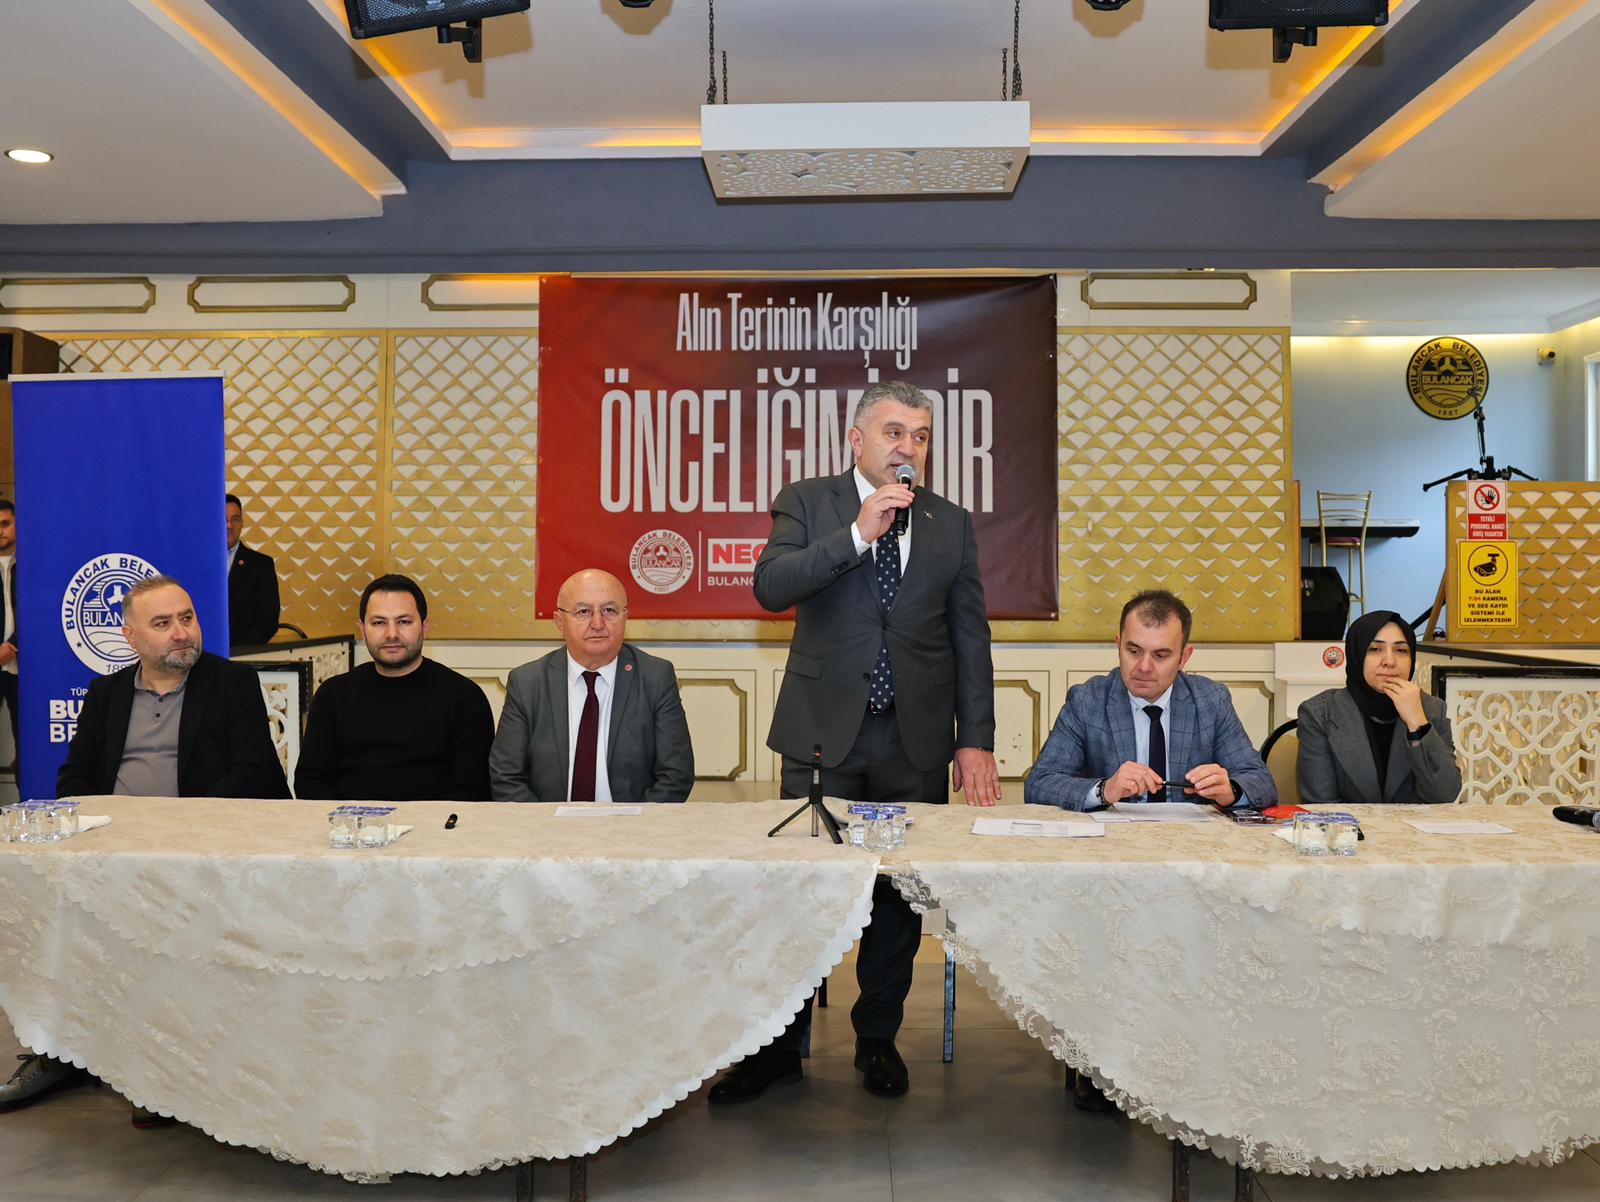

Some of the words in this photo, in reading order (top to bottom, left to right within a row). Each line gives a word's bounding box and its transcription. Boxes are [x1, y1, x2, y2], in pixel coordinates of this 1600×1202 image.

[676, 292, 722, 351] Alın
[727, 292, 812, 351] Terinin
[817, 291, 918, 370] Karşılığı
[1410, 342, 1442, 395] BULANCAK
[1422, 375, 1473, 385] BULANCAK
[631, 531, 658, 570] BULANCAK
[641, 559, 681, 568] BULANCAK
[65, 558, 111, 630] BULANCAK
